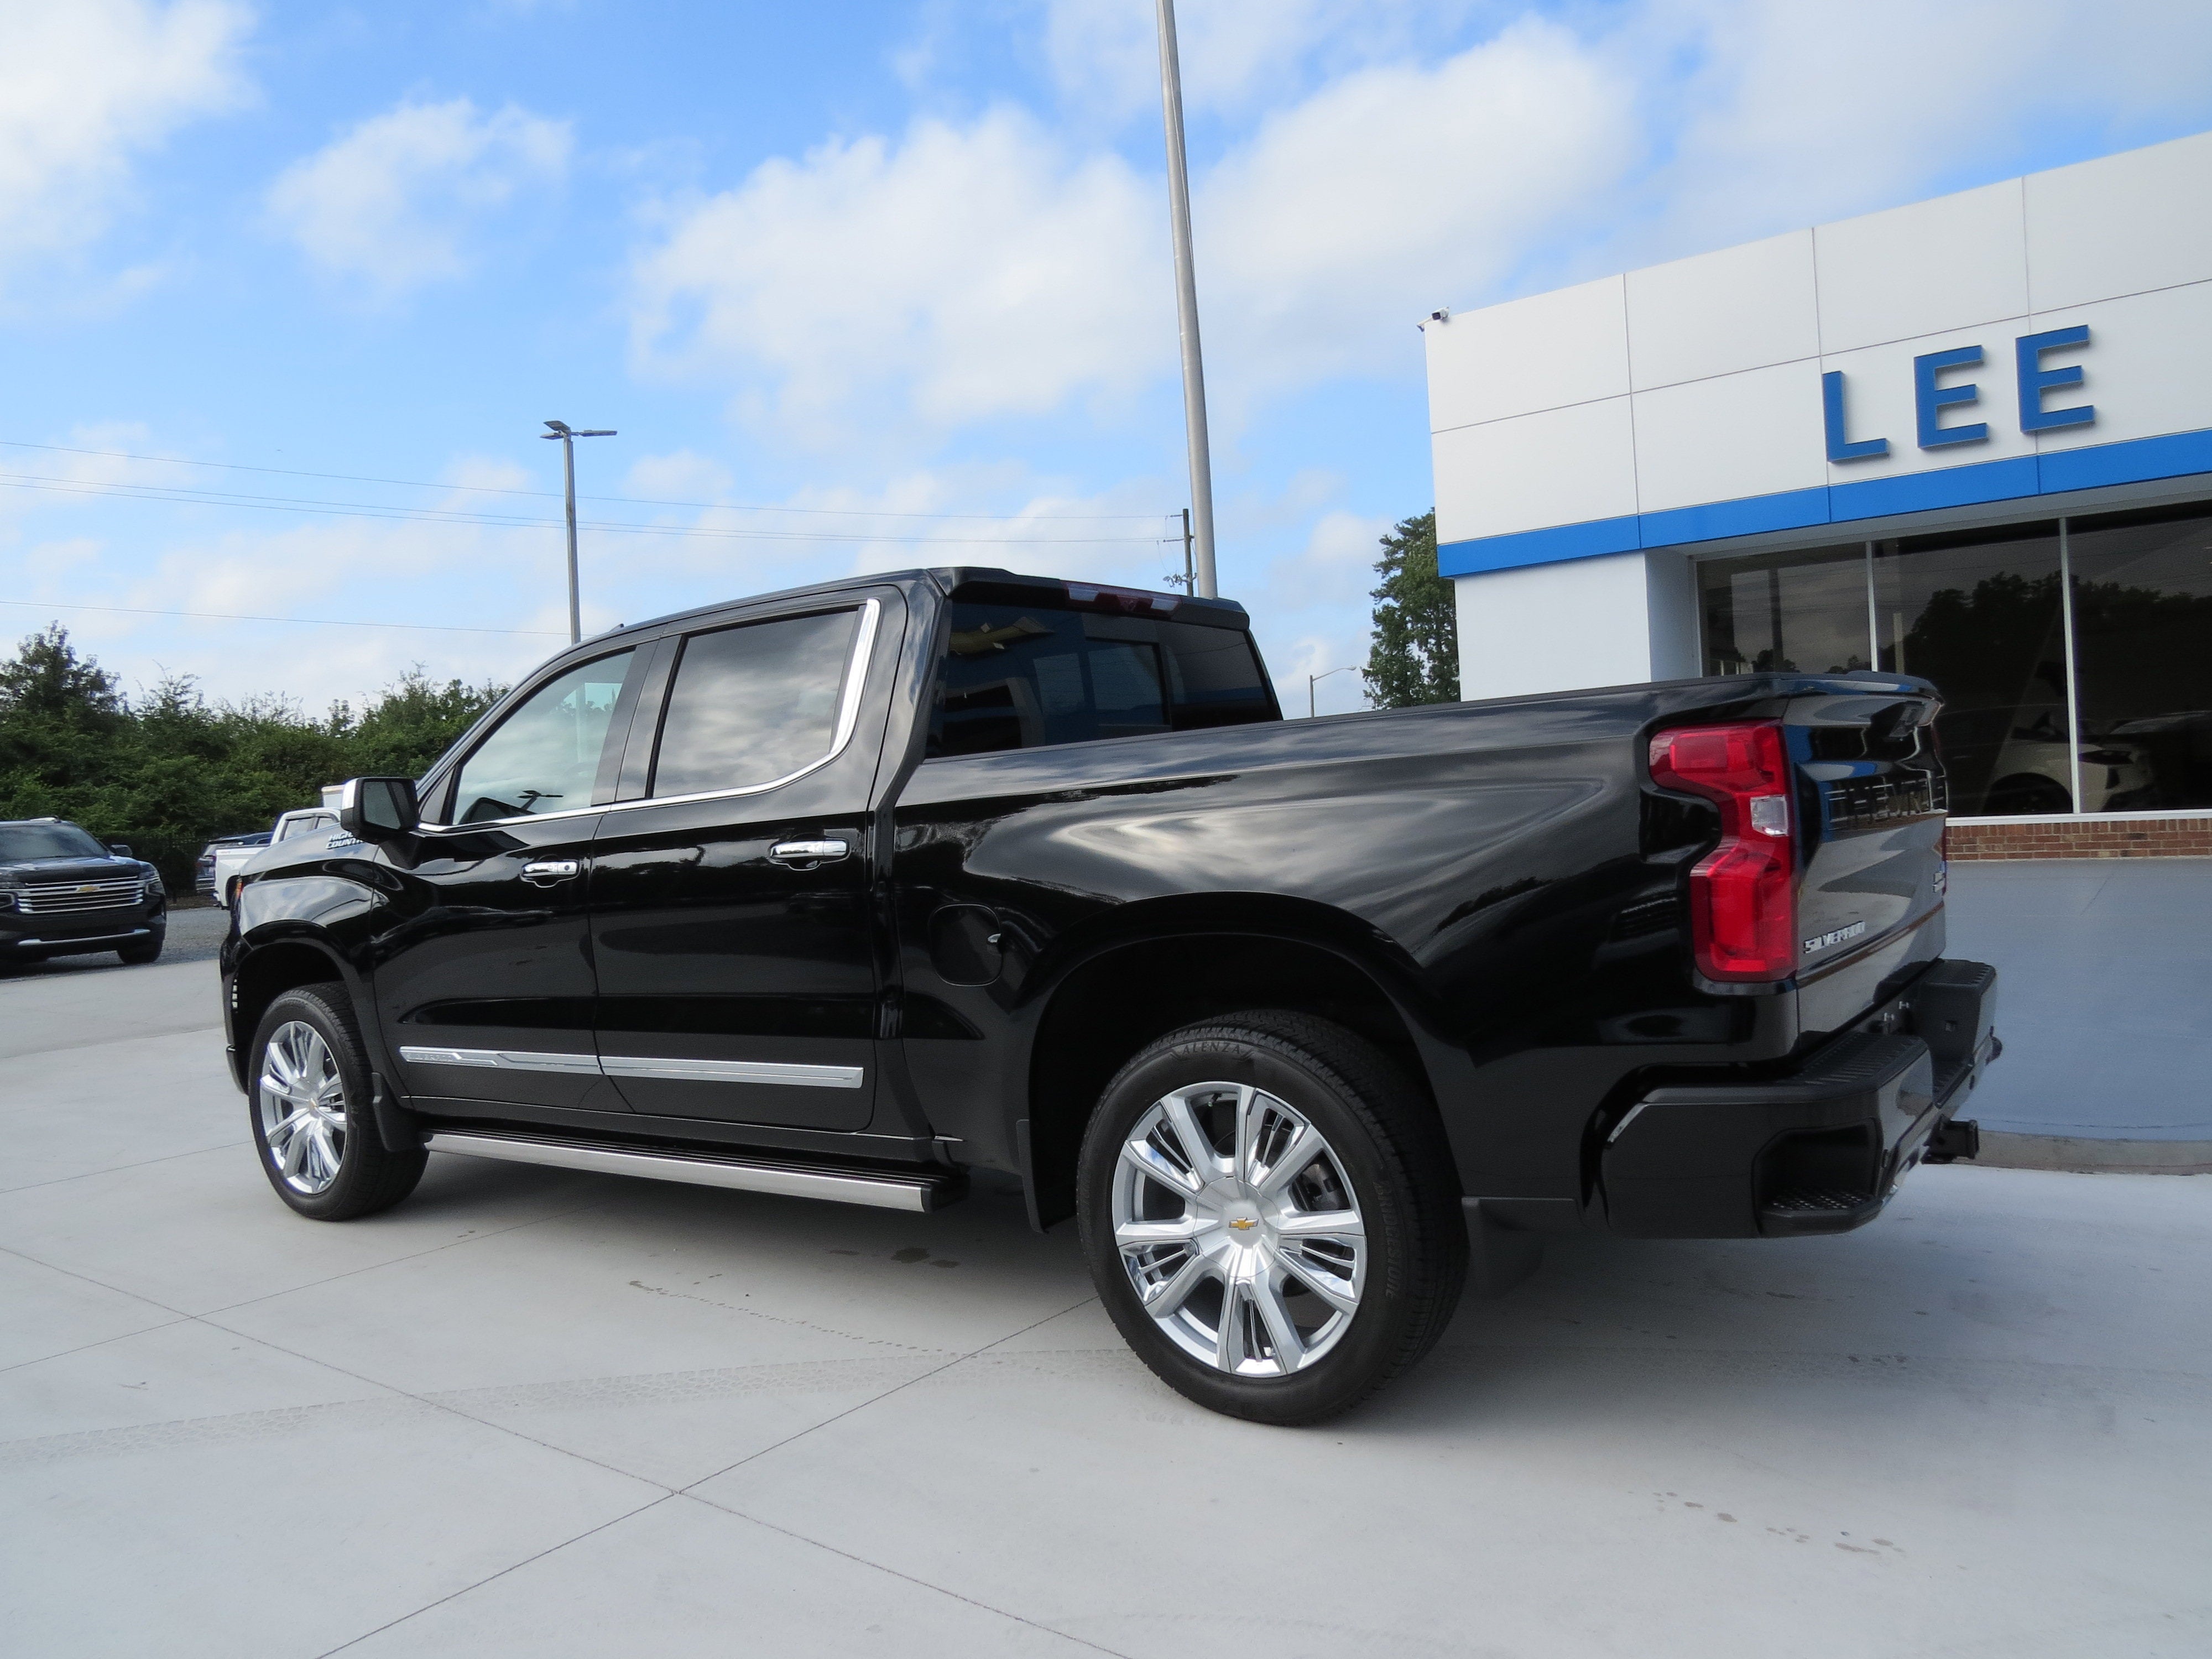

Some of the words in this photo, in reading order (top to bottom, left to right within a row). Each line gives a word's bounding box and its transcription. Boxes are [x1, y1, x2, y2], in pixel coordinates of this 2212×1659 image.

[1822, 324, 2095, 463] LEE
[325, 837, 364, 850] COUNT
[1182, 1041, 1240, 1055] ALENZA
